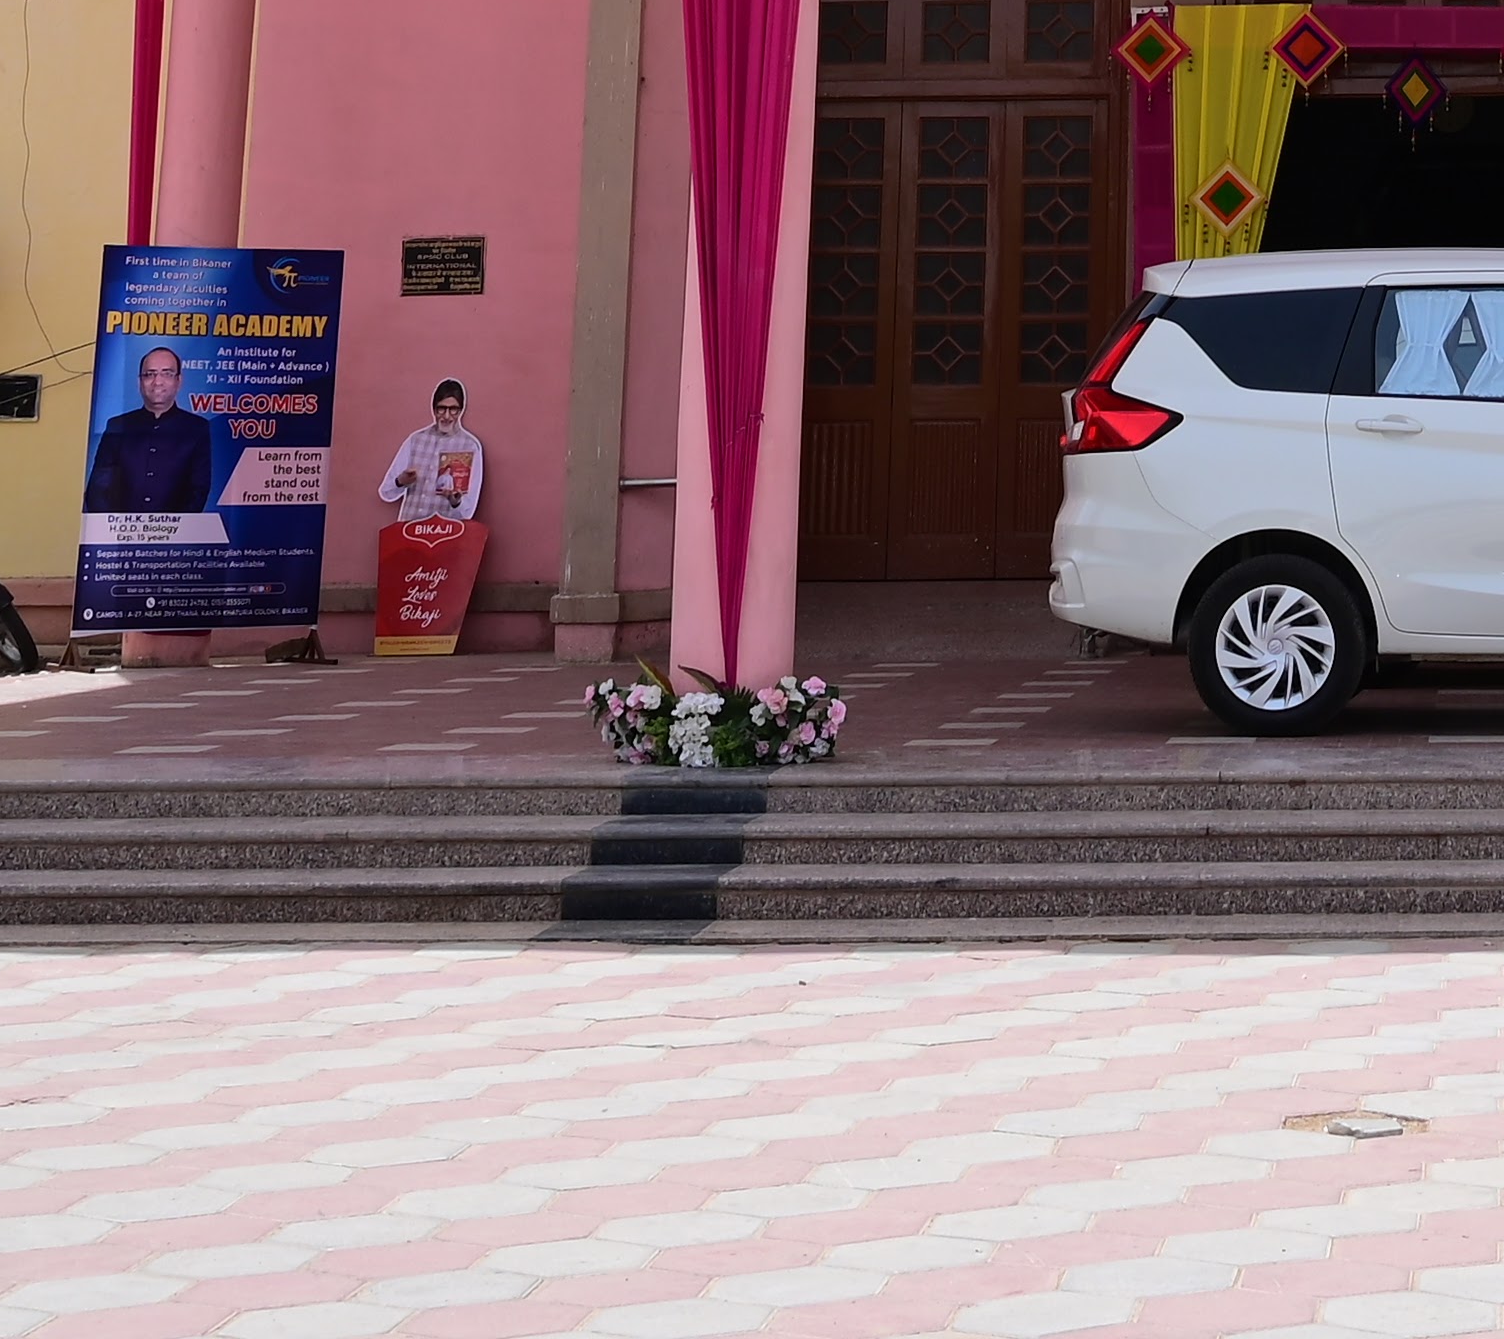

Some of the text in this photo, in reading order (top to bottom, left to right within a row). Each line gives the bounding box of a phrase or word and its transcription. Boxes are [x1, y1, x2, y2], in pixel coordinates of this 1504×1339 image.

[125, 256, 232, 269] First time Bikaner
[161, 271, 189, 279] team
[125, 282, 228, 295] legendary faculties
[124, 296, 214, 308] coming together
[106, 310, 329, 338] PIONEER ACADEMY
[217, 347, 297, 357] An institute for
[181, 360, 323, 373] NEET, JEE (Main Advance
[244, 375, 303, 385] Foundation
[189, 392, 318, 414] WELCOMES
[228, 418, 276, 440] YOU
[258, 450, 322, 462] Learn from
[273, 464, 322, 475] the best
[264, 477, 320, 489] stand out
[242, 491, 319, 503] from the rest
[107, 514, 121, 524] Dr.
[148, 514, 182, 524] Suthar
[142, 523, 179, 535] Biology
[414, 523, 453, 535] BIKAJI
[402, 585, 438, 605] Loves
[399, 604, 442, 628] Bikaji
